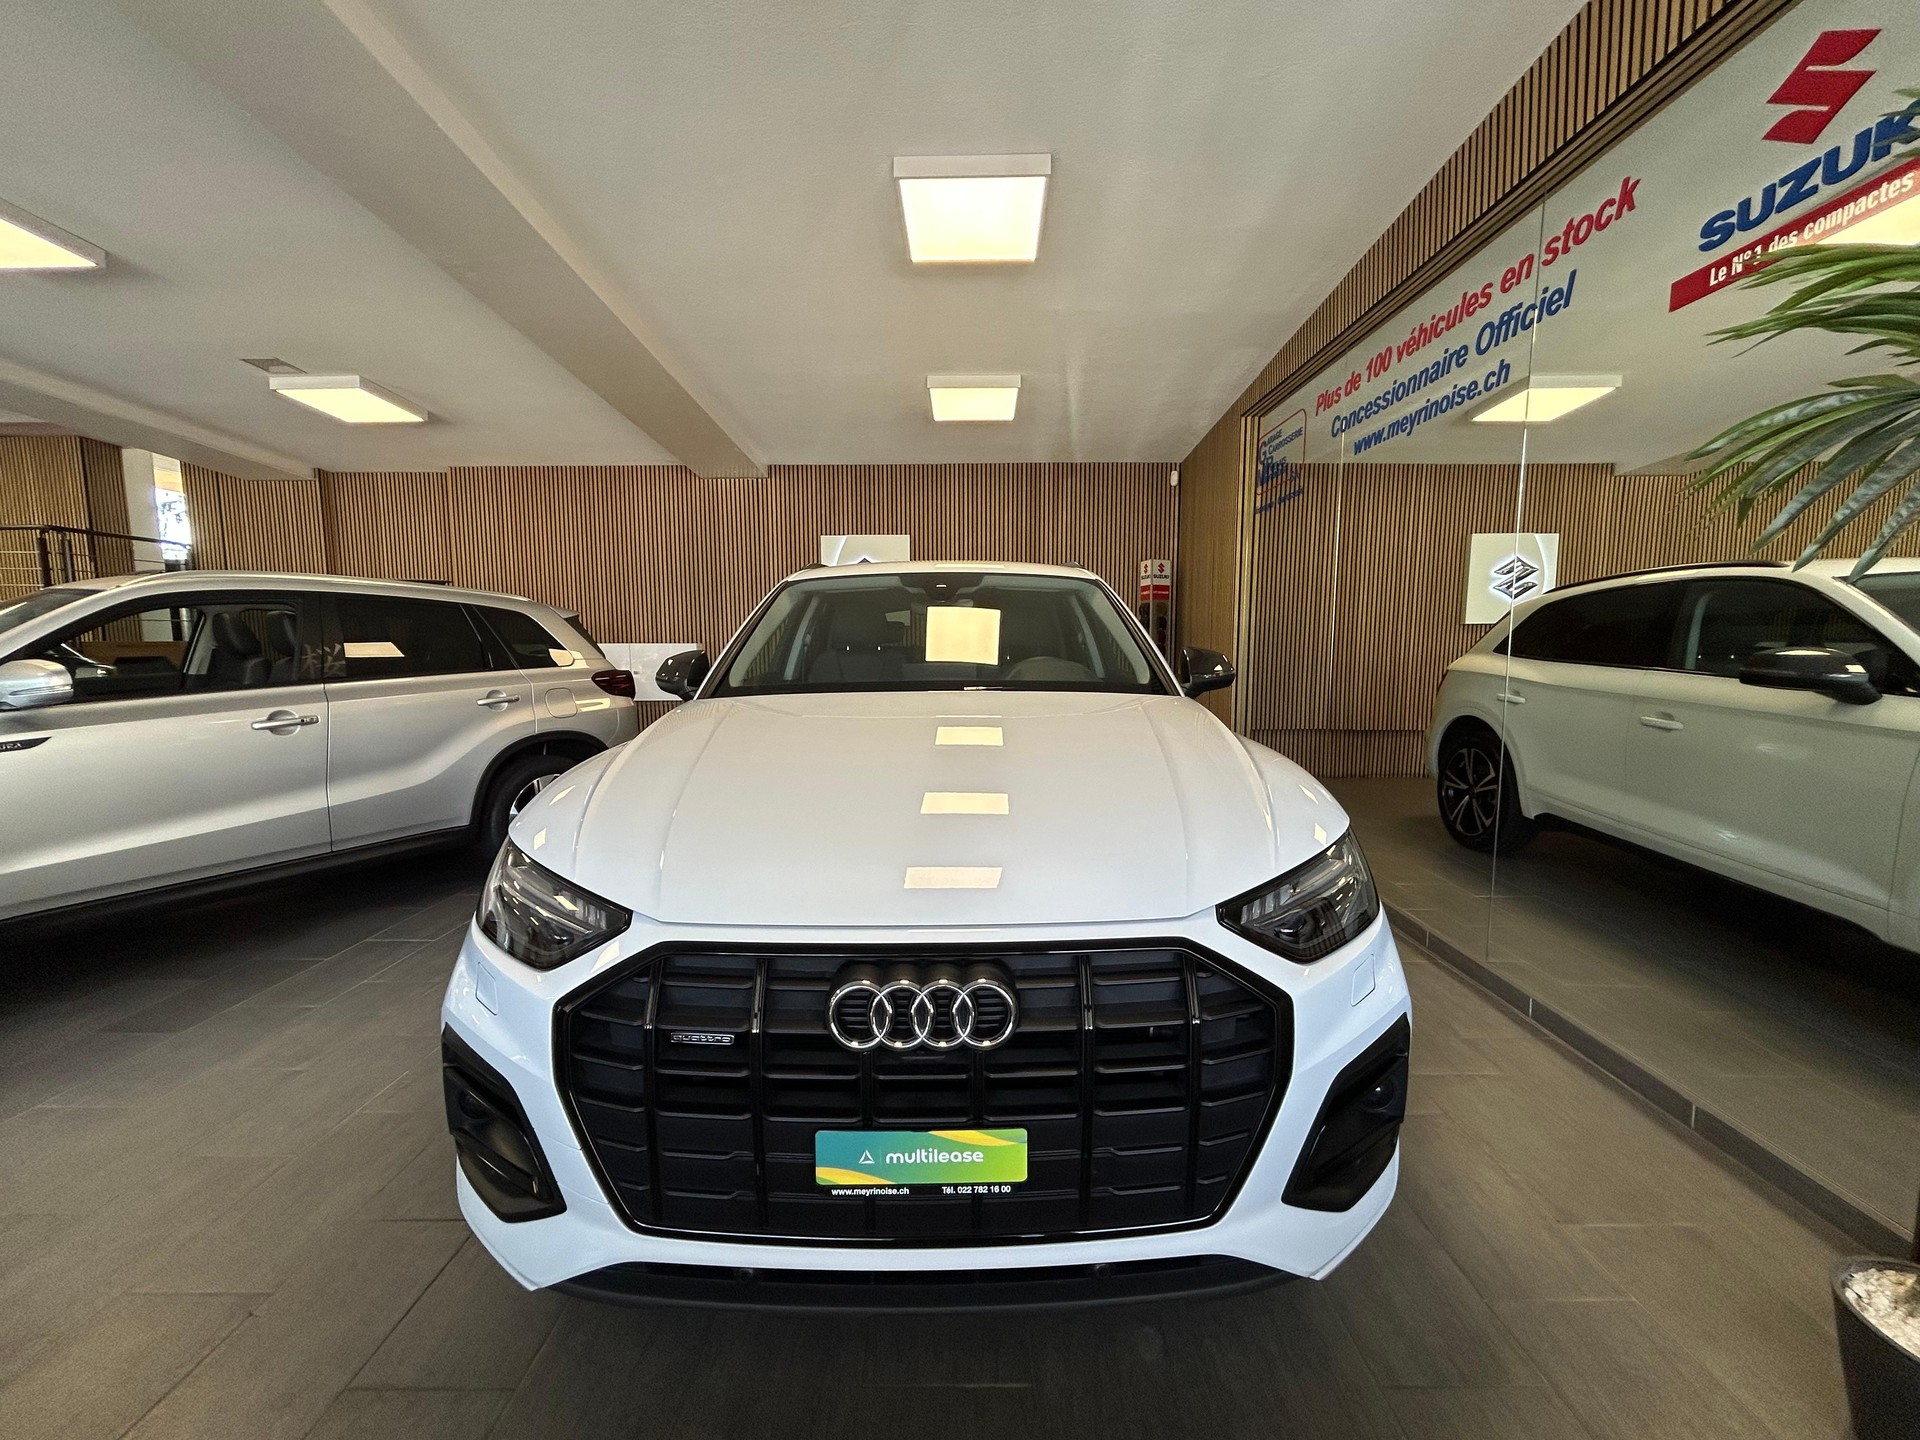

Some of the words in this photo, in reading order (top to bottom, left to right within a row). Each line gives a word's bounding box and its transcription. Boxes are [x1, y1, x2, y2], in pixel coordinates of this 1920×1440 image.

[1709, 266, 1728, 287] Le
[1768, 230, 1799, 252] des
[1803, 171, 1915, 240] compactes
[1315, 386, 1342, 417] Plus
[1344, 371, 1362, 397] de
[1366, 346, 1393, 383] 100
[1396, 282, 1494, 363] véhicules
[1500, 253, 1535, 294] en
[1541, 176, 1642, 267] stock
[1331, 344, 1469, 438] Concessionnaire
[1475, 269, 1578, 355] Officiel
[1353, 359, 1511, 455] www.meyrinoise.ch
[831, 1187, 910, 1197] www.meyrinoise.ch
[885, 1148, 984, 1164] multilease
[941, 1186, 956, 1194] Tél.
[957, 1186, 972, 1194] 022
[973, 1185, 989, 1194] 782
[1001, 1185, 1011, 1193] 00
